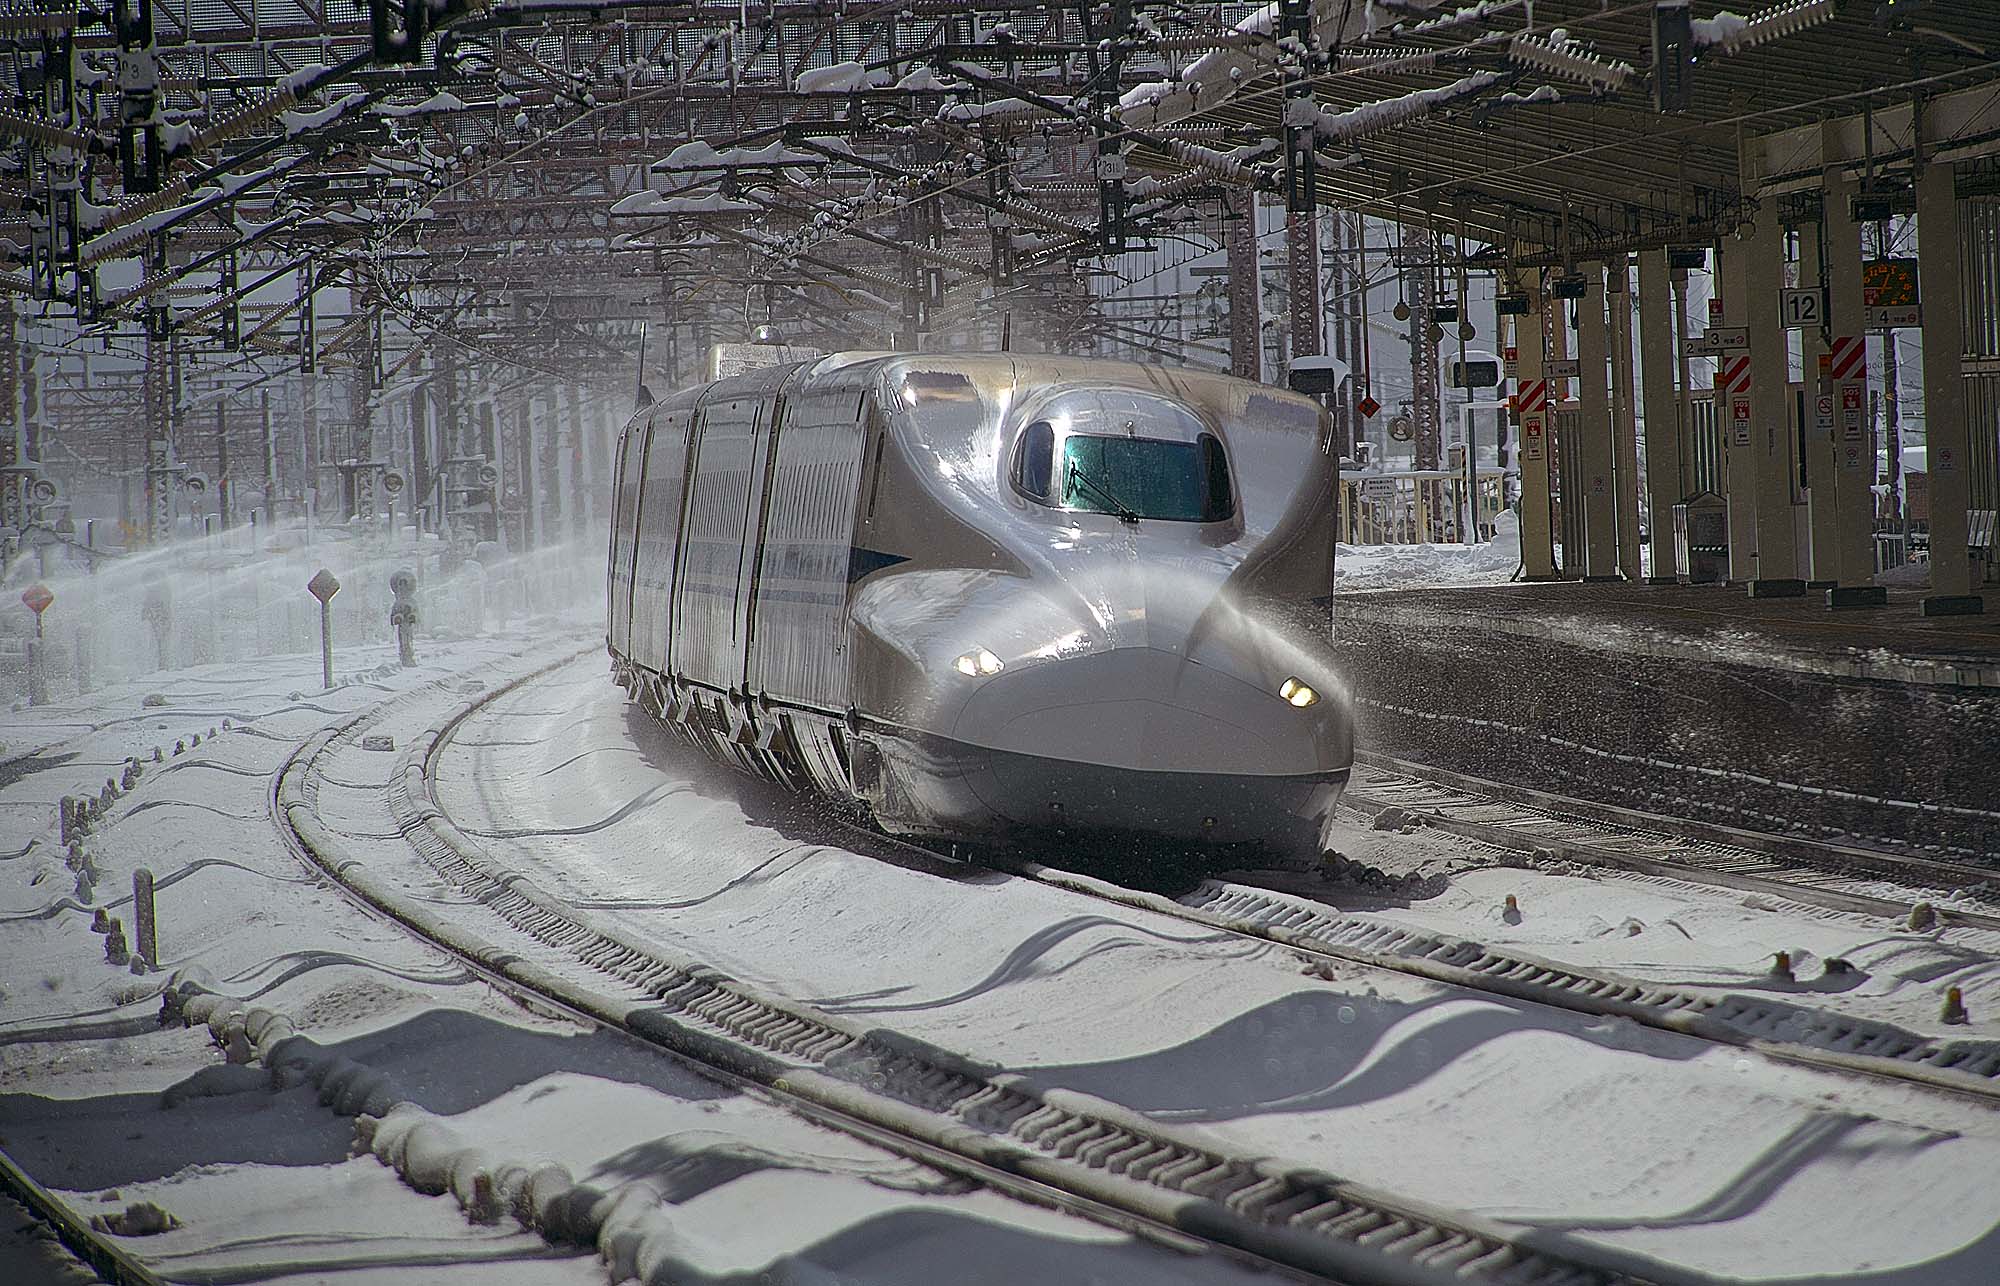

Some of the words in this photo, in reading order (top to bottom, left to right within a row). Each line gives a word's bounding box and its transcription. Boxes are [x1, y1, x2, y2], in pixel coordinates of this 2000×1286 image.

[1790, 295, 1817, 320] 12
[1880, 310, 1890, 324] 4
[1711, 333, 1720, 345] 3
[1687, 343, 1694, 354] 2
[1548, 365, 1553, 374] 1
